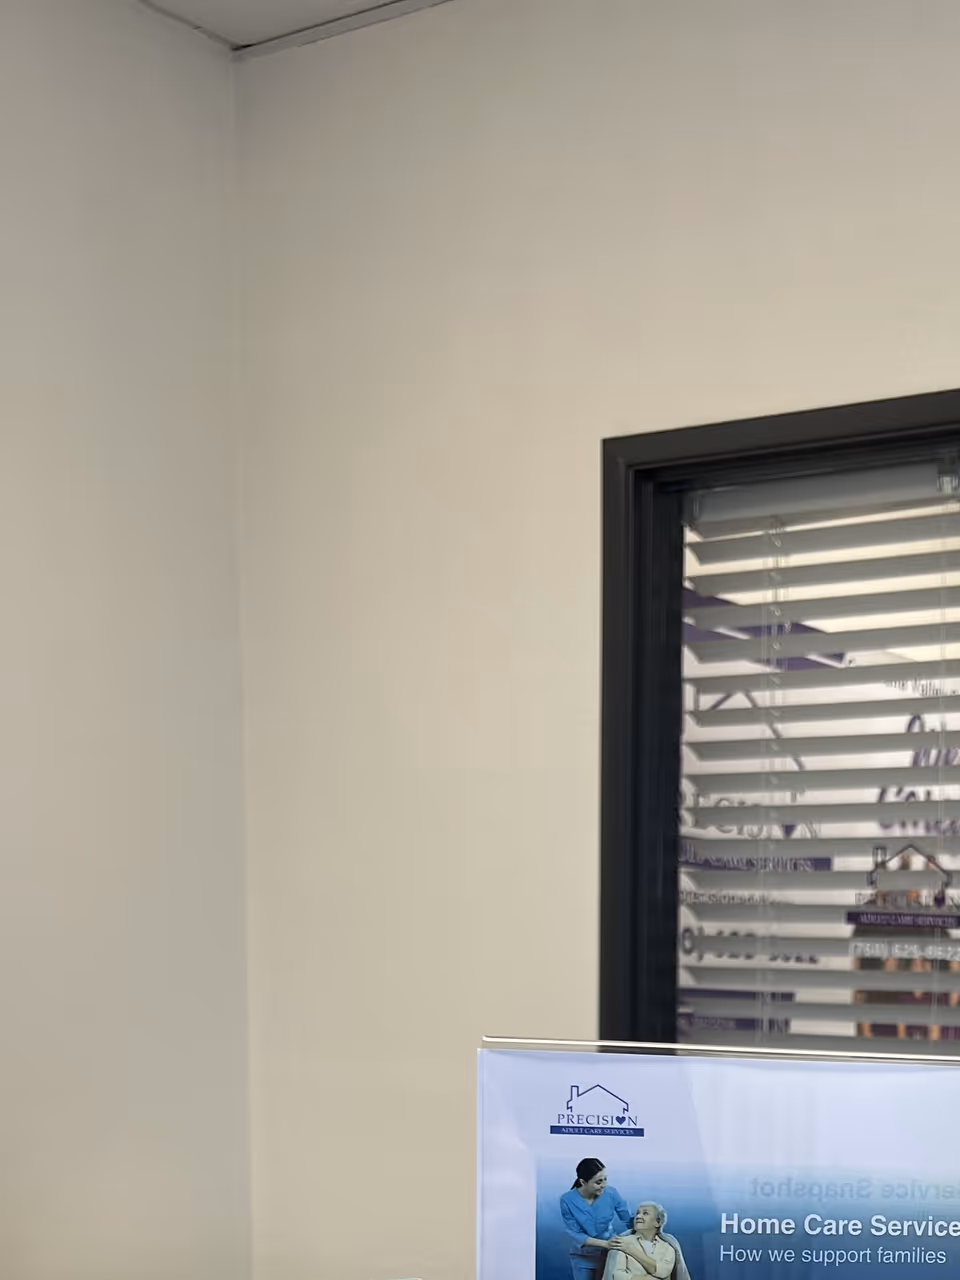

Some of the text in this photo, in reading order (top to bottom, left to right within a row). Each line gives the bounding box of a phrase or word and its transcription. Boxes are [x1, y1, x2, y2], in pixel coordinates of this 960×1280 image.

[584, 1127, 602, 1135] CARE
[603, 1128, 635, 1136] SERVICES
[720, 1212, 797, 1235] Home
[804, 1212, 864, 1237] Care
[719, 1244, 948, 1269] How we support families
